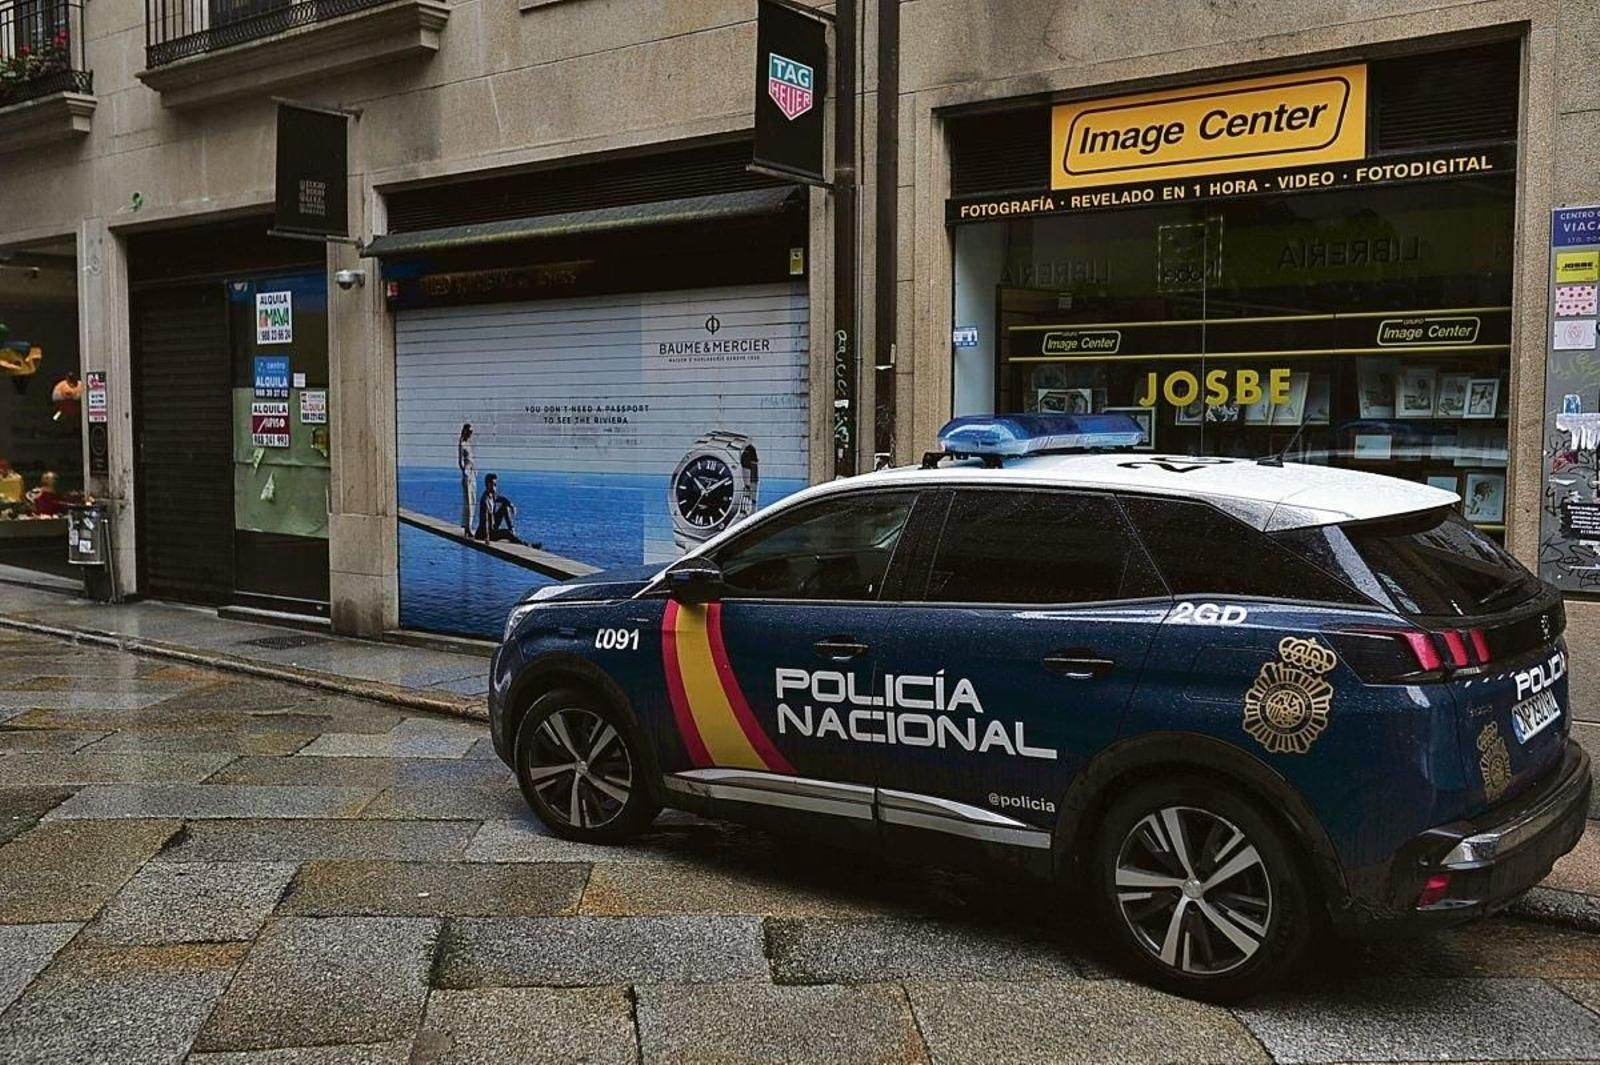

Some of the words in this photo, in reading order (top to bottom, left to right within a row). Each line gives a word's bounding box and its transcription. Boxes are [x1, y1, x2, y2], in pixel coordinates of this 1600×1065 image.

[773, 59, 809, 88] TAG
[771, 81, 811, 116] HEUER
[1079, 121, 1185, 155] Image
[1199, 102, 1329, 140] Center
[961, 195, 1055, 218] FOTOGRAFÍA
[1071, 188, 1154, 208] REVELADO
[1163, 186, 1185, 200] EN
[1194, 184, 1201, 197] 1
[1209, 180, 1258, 196] HORA
[1278, 171, 1334, 189] VIDEO
[1356, 155, 1493, 182] FOTODIGITAL
[1560, 211, 1595, 221] CENTRO
[260, 293, 288, 305] ALQUILA
[1383, 326, 1423, 341] Image
[1428, 325, 1473, 338] Center
[1047, 338, 1078, 351] Image
[1081, 337, 1116, 349] Center
[255, 376, 288, 388] ALQUILA
[1139, 368, 1291, 407] JOSBE
[253, 404, 287, 414] ALQUILA
[525, 405, 541, 413] YOU
[544, 405, 568, 413] DON'T
[571, 405, 593, 413] NEED
[605, 404, 649, 413] PASSPORT
[544, 416, 554, 424] TO
[557, 416, 572, 424] SEE
[594, 416, 629, 425] RIVIERA
[1173, 602, 1248, 626] 2GD
[602, 628, 639, 650] 091
[775, 667, 984, 713] POLICÍA
[777, 702, 1058, 760] NACIONAL
[988, 792, 1056, 813] @policia
